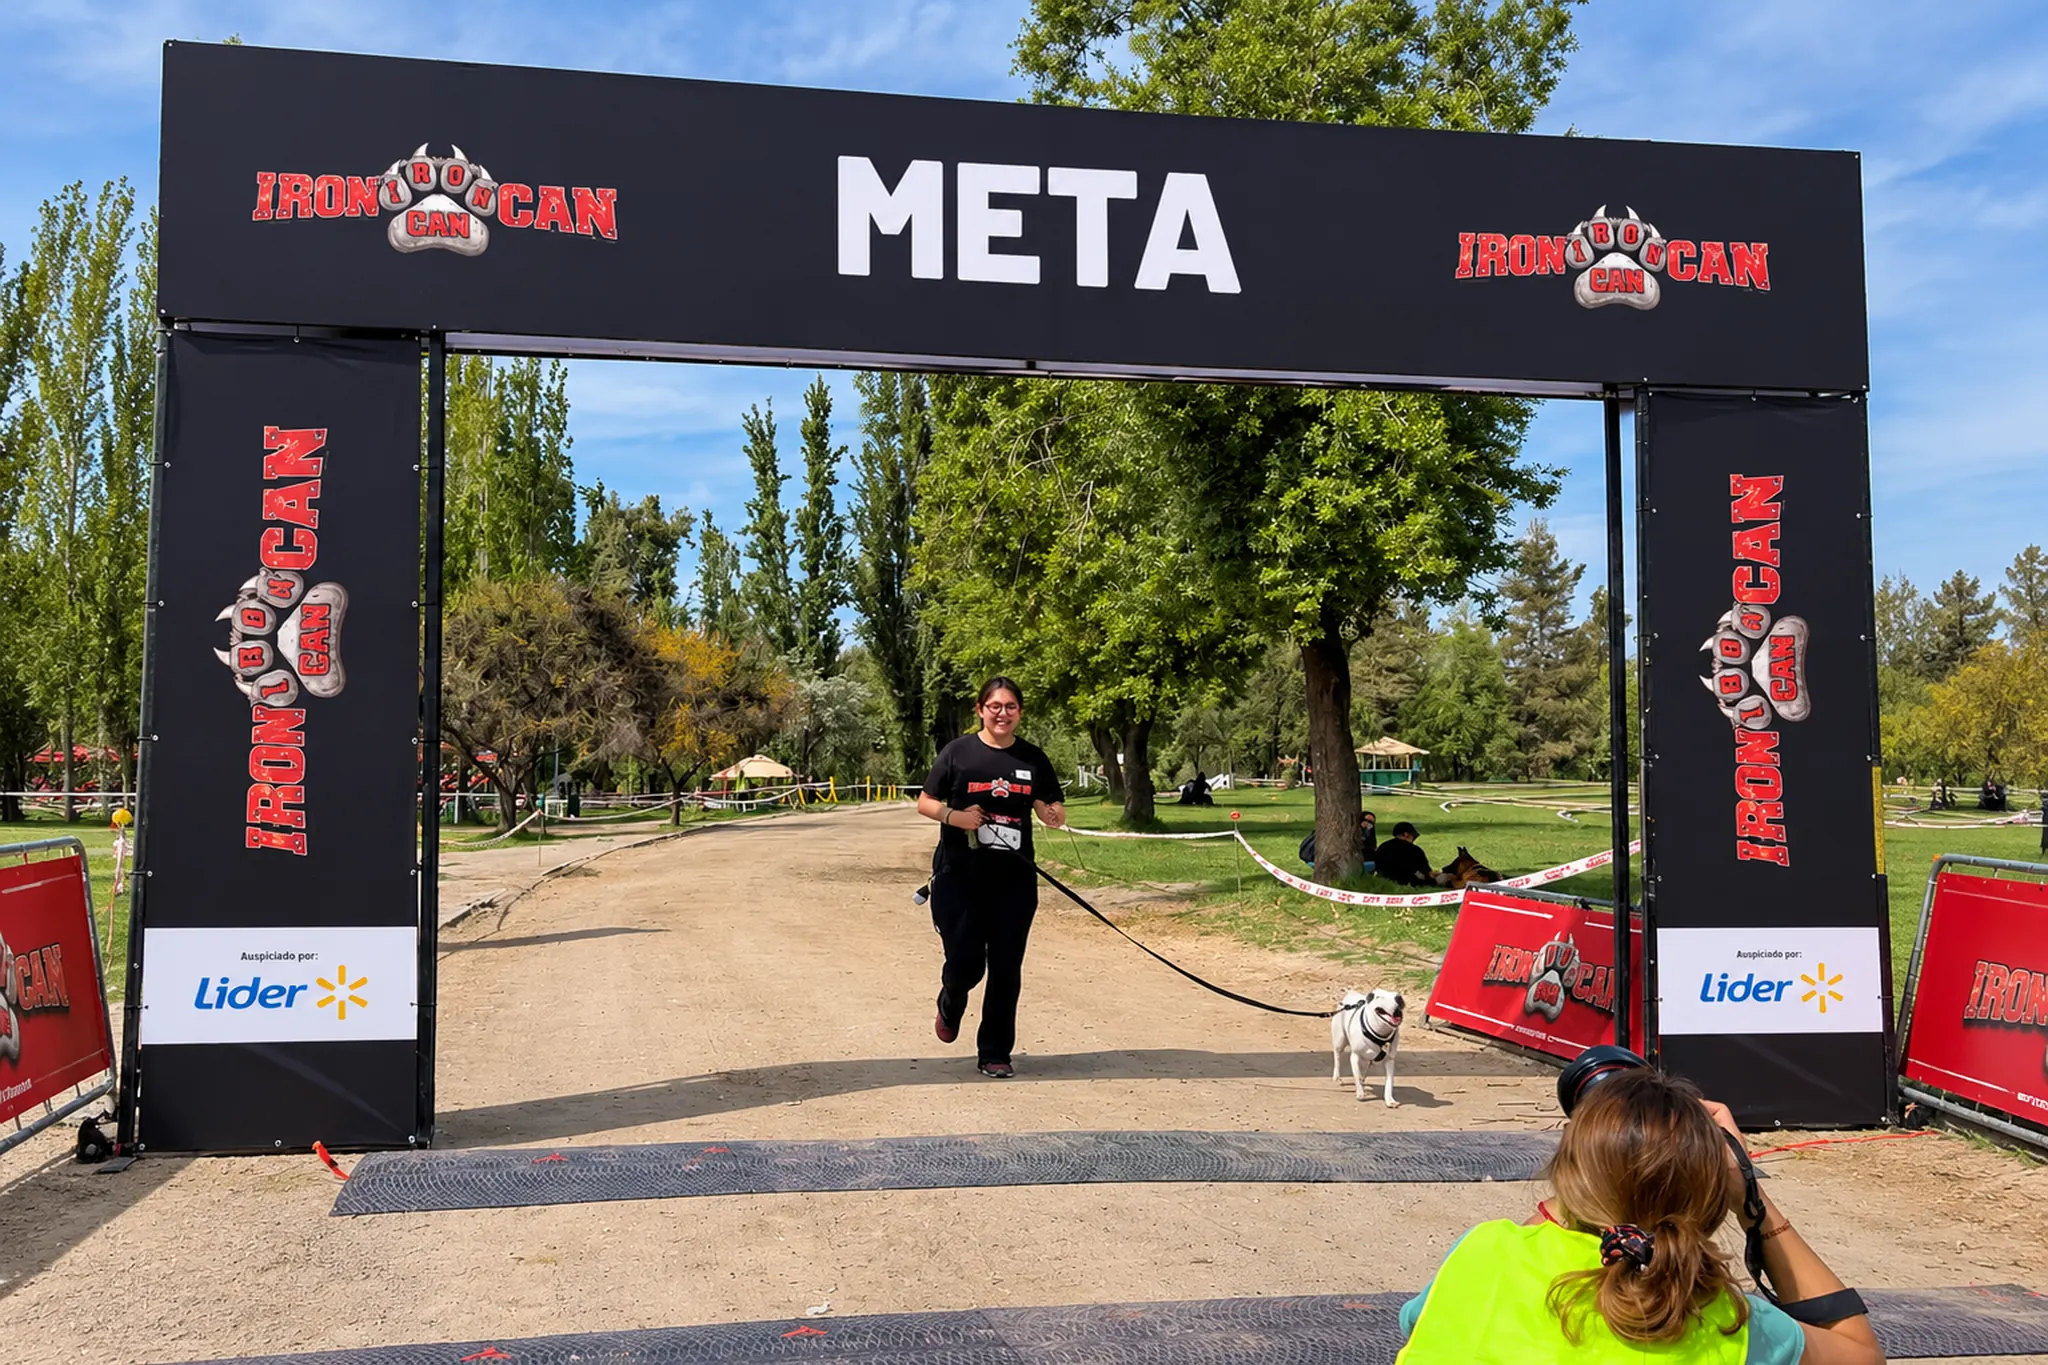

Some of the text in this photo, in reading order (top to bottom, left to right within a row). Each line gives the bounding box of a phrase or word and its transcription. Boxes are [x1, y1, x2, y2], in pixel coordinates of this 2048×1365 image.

[252, 171, 618, 241] IRON CAN
[406, 209, 470, 239] CAN
[838, 155, 1242, 294] META
[1455, 232, 1771, 291] IRON CAN
[1590, 267, 1646, 294] CAN
[245, 425, 328, 856] IRON CAN
[298, 602, 332, 677] CAN
[1730, 474, 1790, 867] IRON CAN
[1768, 634, 1799, 702] CAN
[15, 944, 69, 1011] CAN
[240, 951, 319, 963] Auspiciado por:
[1736, 950, 1803, 960] Auspiciado por:
[194, 976, 308, 1010] Lider
[1699, 973, 1793, 1003] Lider
